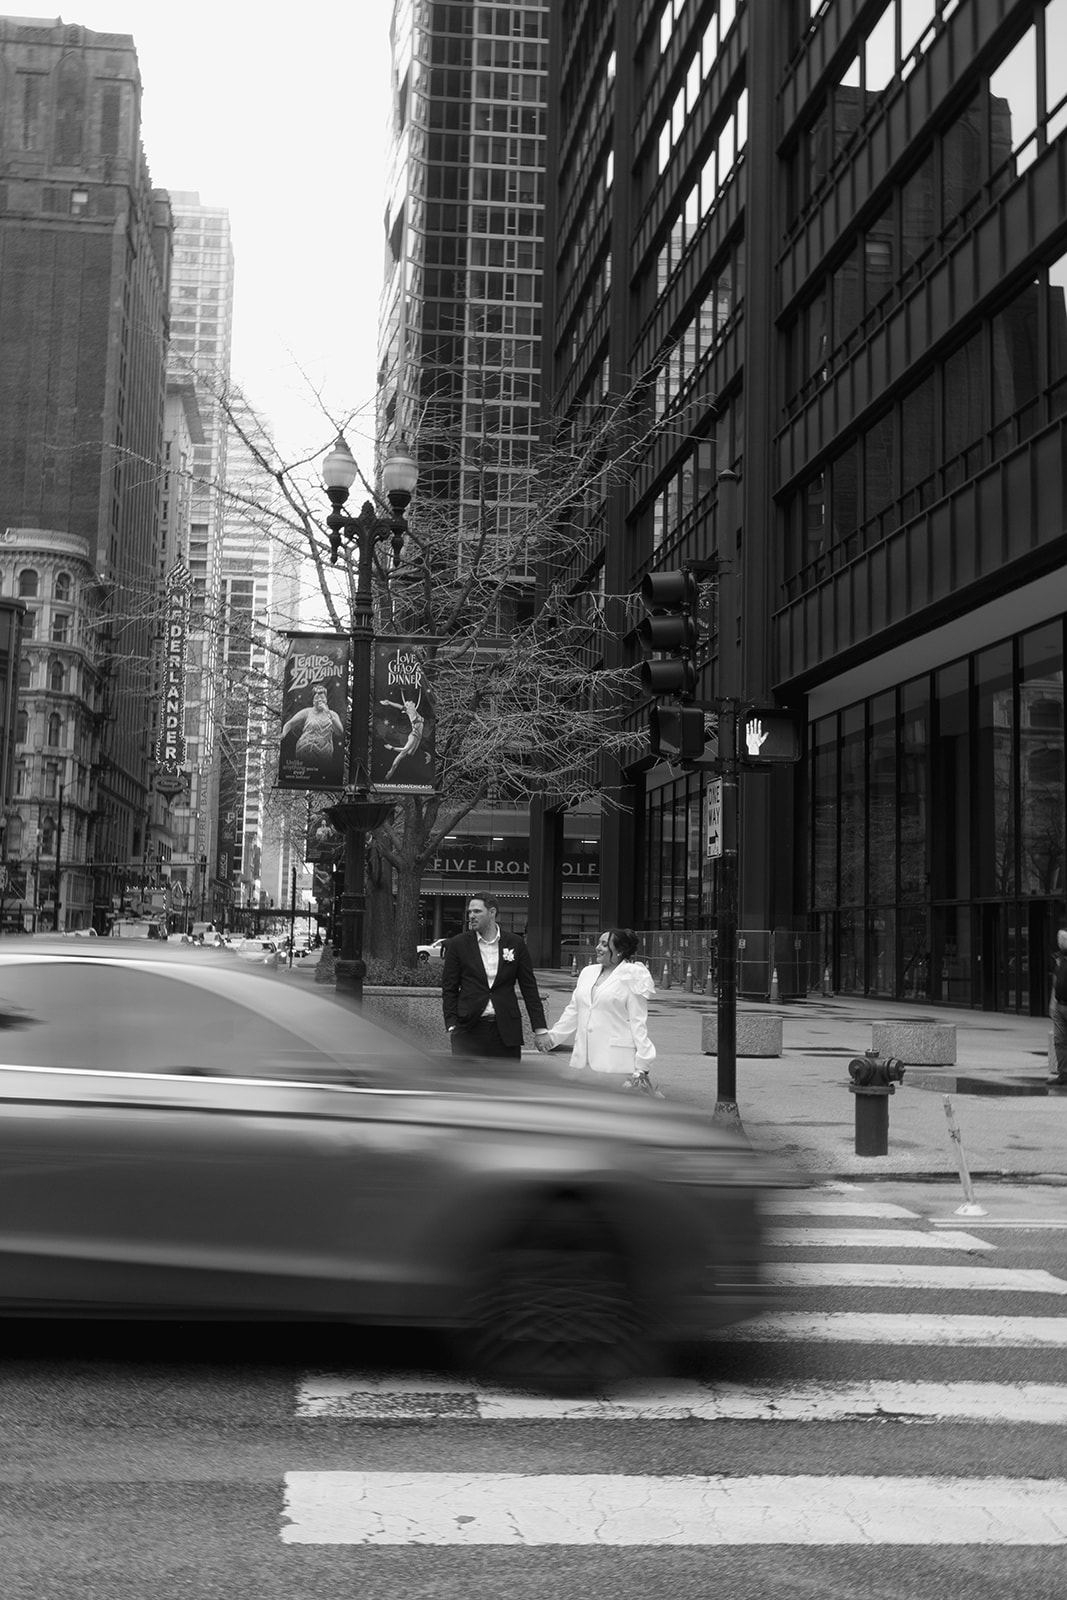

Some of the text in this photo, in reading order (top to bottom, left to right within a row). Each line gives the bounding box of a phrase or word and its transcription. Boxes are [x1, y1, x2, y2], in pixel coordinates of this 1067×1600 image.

[166, 594, 184, 759] NEDERLANDER
[388, 672, 422, 689] DINNER
[708, 785, 720, 805] ONE
[708, 806, 721, 826] WAY
[433, 858, 477, 872] FIVE
[561, 862, 597, 876] OLF
